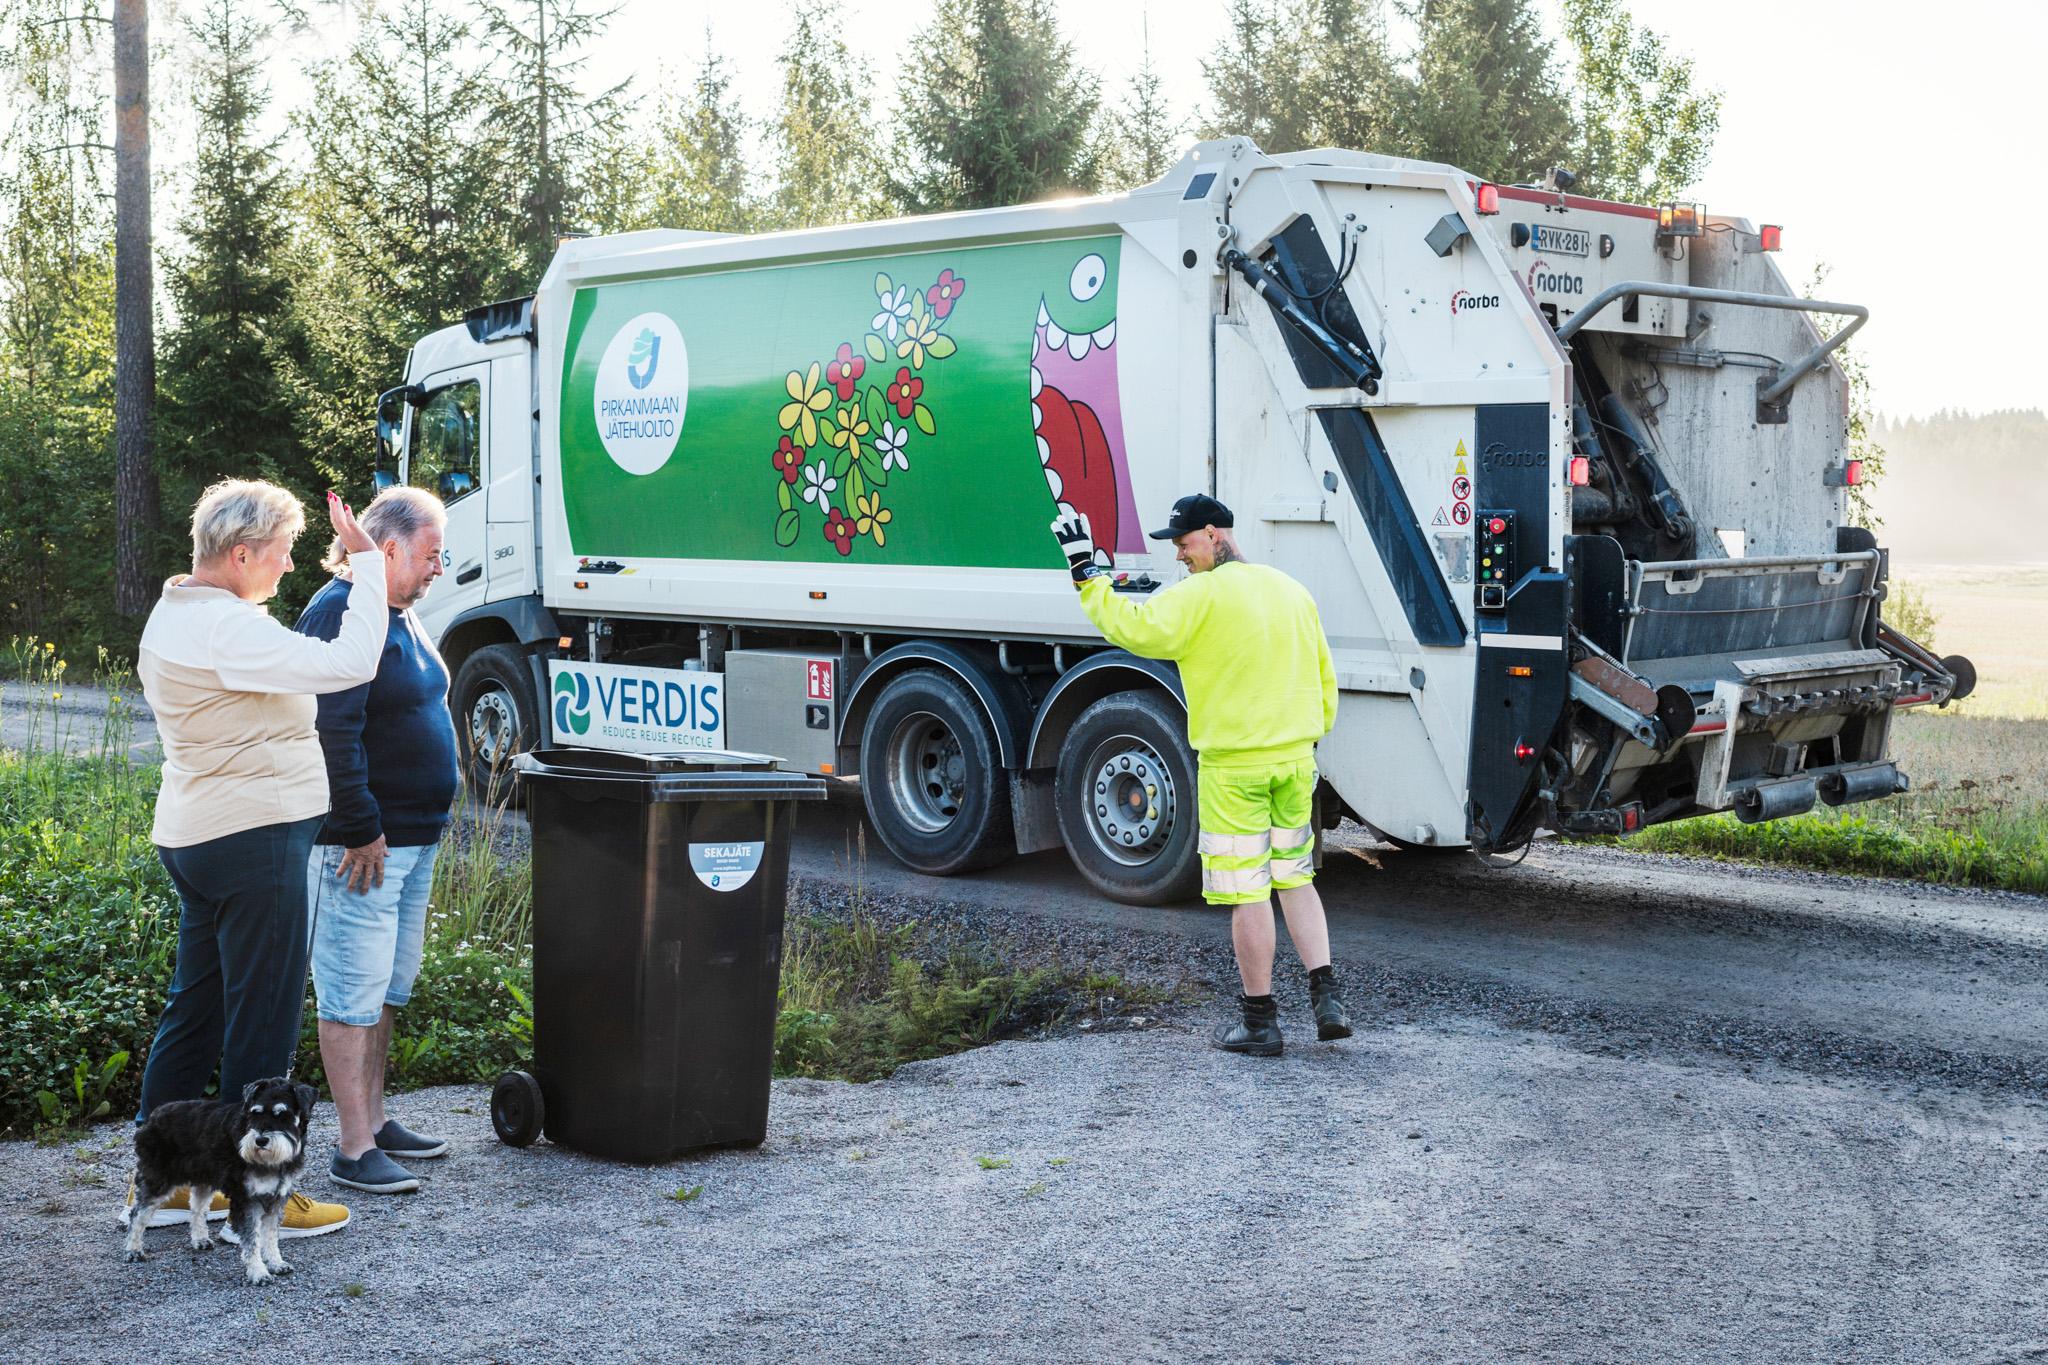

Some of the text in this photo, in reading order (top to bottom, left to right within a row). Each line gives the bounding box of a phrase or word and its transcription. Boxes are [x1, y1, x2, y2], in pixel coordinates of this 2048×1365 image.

[1537, 272, 1583, 294] norba
[1459, 294, 1499, 309] norba
[601, 396, 679, 417] PIRKANMAAN
[605, 419, 674, 440] JÄTEHUOLTO
[494, 545, 514, 560] 380
[595, 676, 719, 732] VERDIS
[602, 725, 712, 748] REDUCE REUSE RECYCLE
[703, 844, 752, 858] SEKAJÄTE
